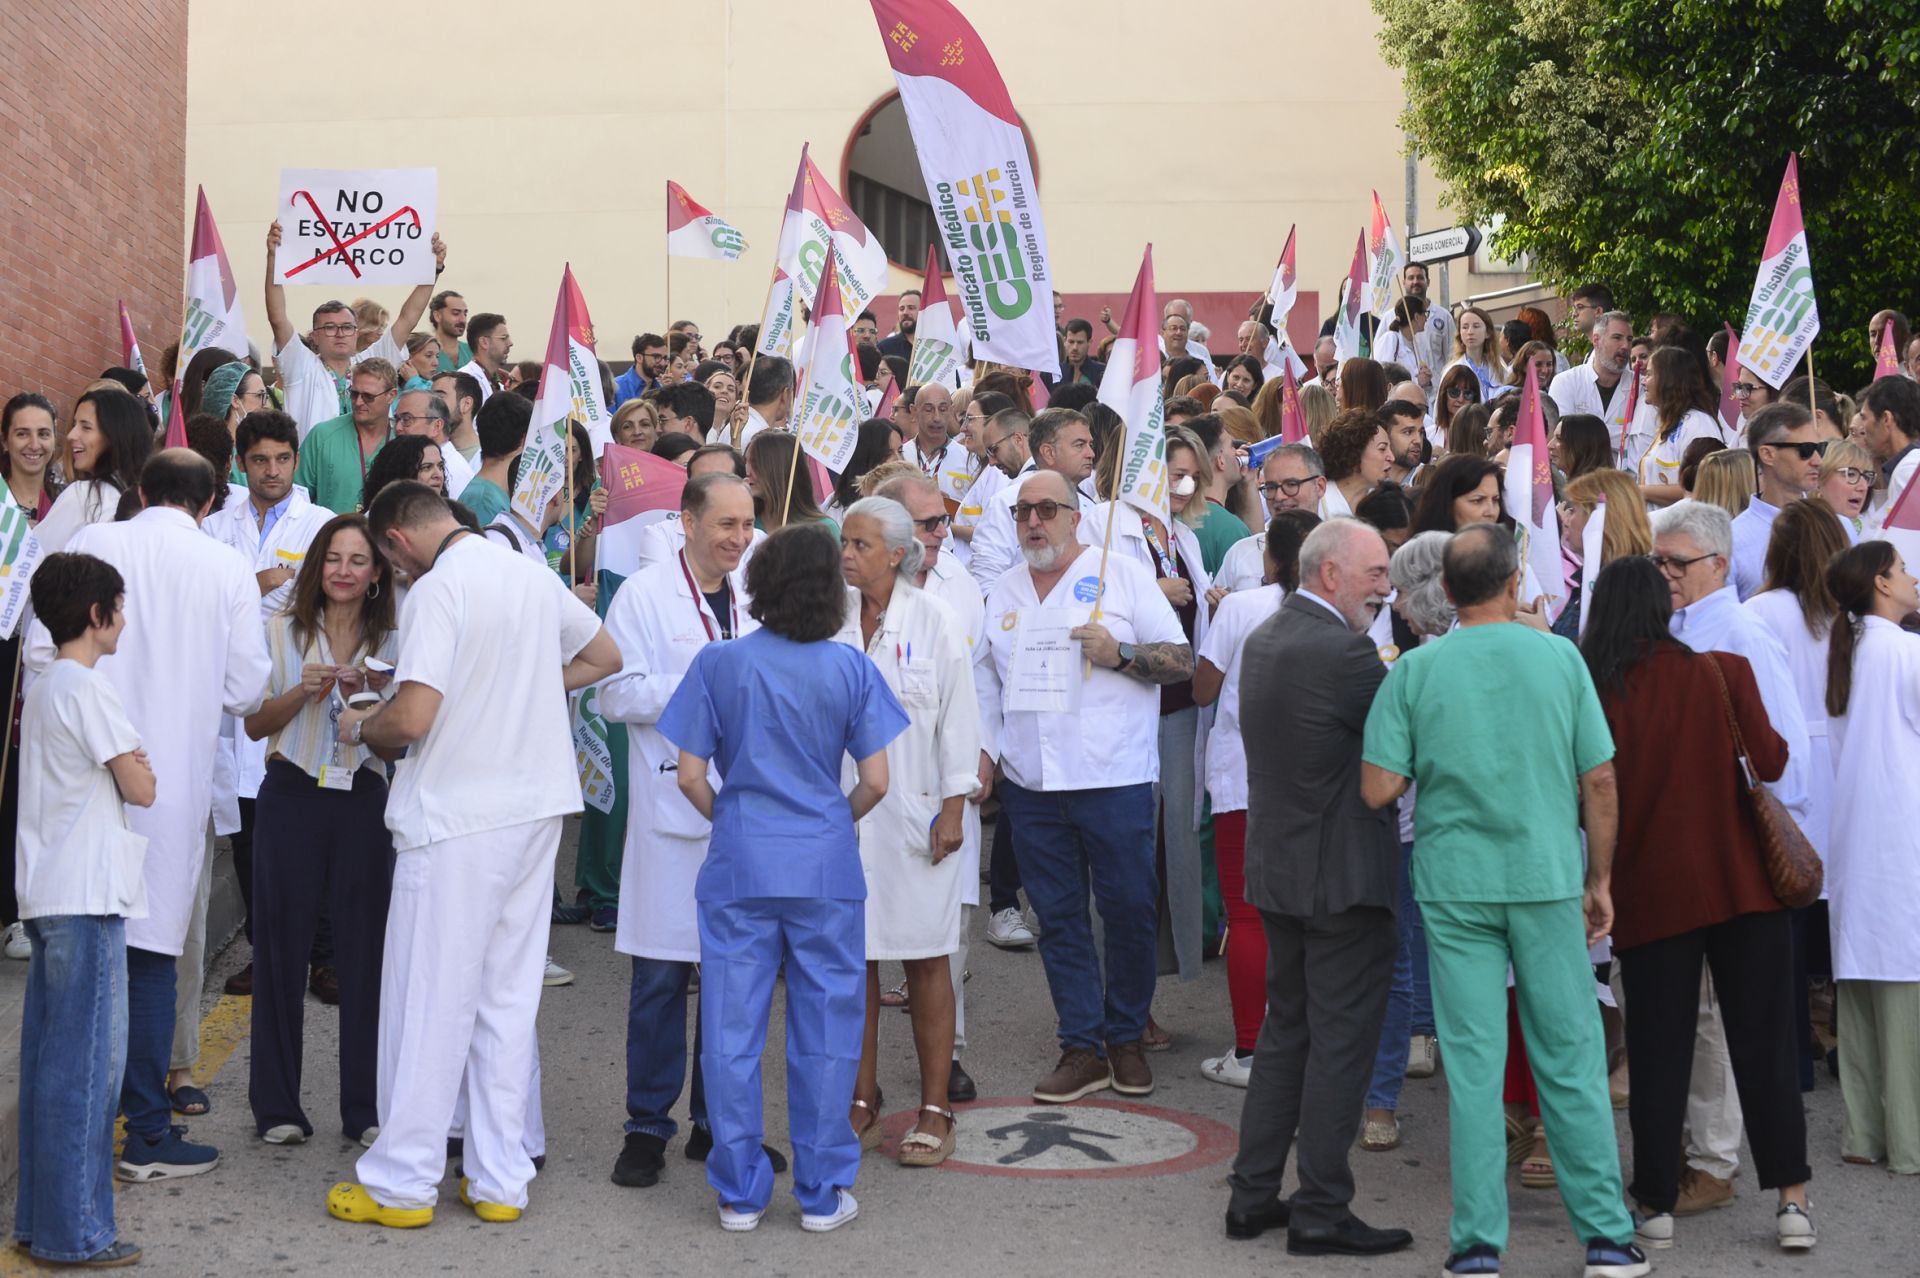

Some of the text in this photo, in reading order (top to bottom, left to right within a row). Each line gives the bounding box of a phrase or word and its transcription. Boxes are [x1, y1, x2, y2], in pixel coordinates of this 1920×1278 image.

[336, 189, 383, 214] NO
[1005, 160, 1046, 282] Región de Murcia
[298, 219, 422, 240] ESTATUTO
[956, 167, 1033, 321] CESM
[1435, 236, 1464, 250] COMERCIAL
[314, 247, 405, 266] MARCO
[936, 182, 991, 343] Sindicato Médico
[843, 264, 869, 302] Médico
[581, 379, 599, 423] Médico
[578, 724, 603, 757] Región
[600, 754, 612, 769] de
